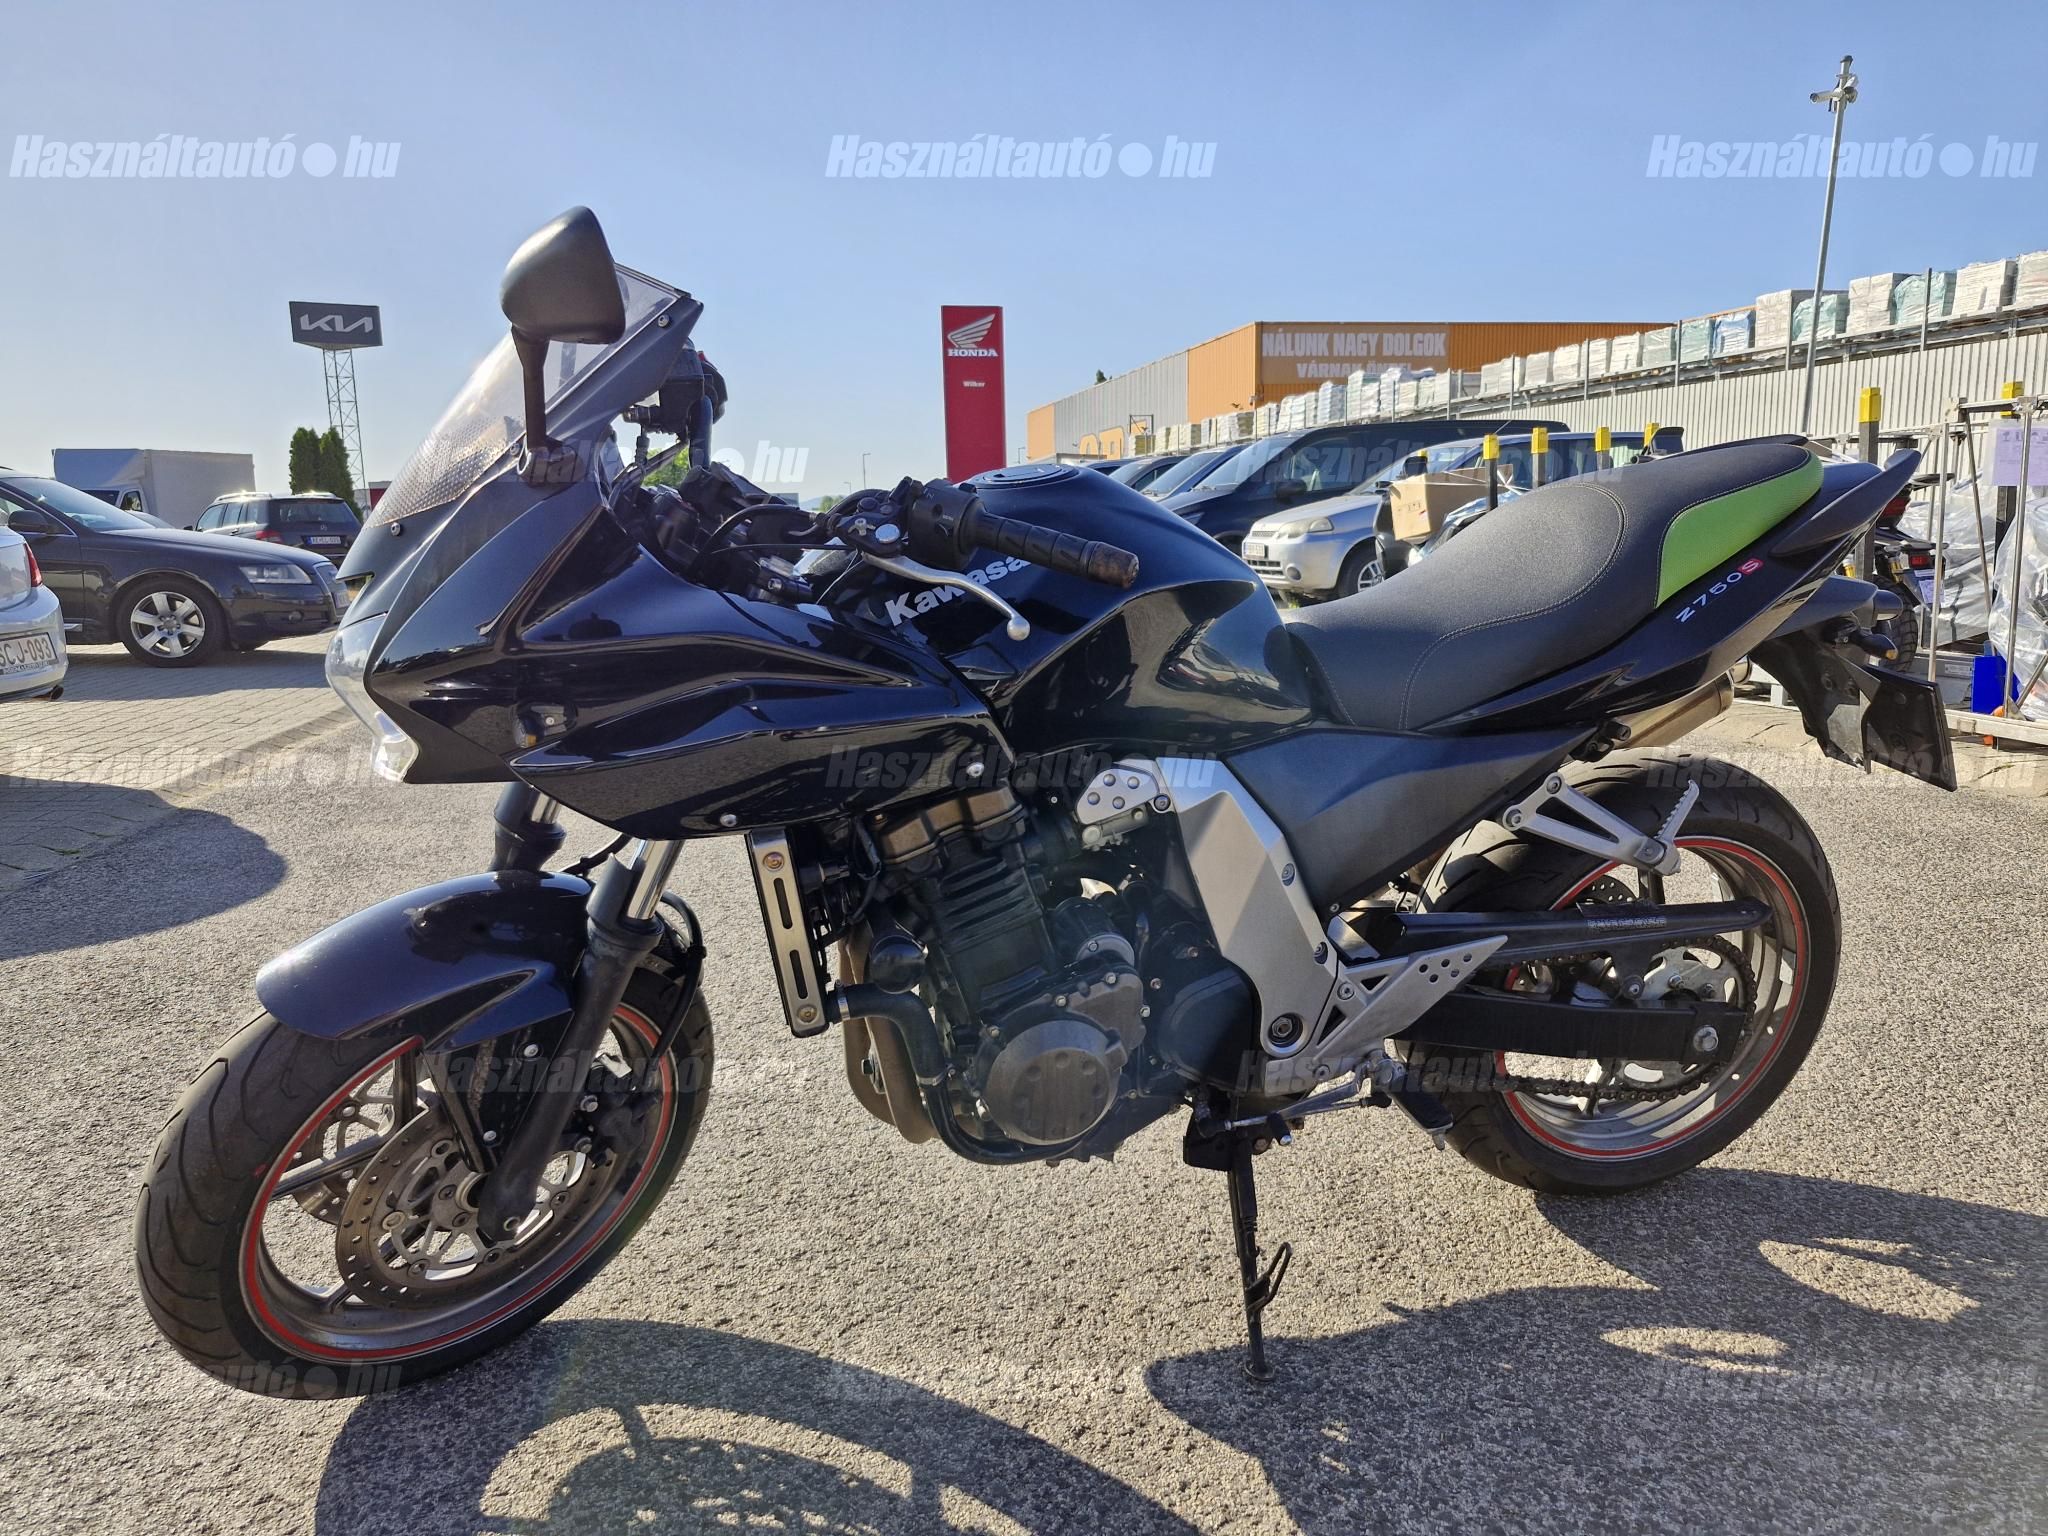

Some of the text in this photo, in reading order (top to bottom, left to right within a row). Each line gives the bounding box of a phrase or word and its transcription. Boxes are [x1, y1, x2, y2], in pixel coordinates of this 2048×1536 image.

[948, 348, 999, 357] HONDA
[1262, 328, 1446, 357] NÁLUNK NAGY DOLGOK
[885, 556, 1032, 627] Kawasa
